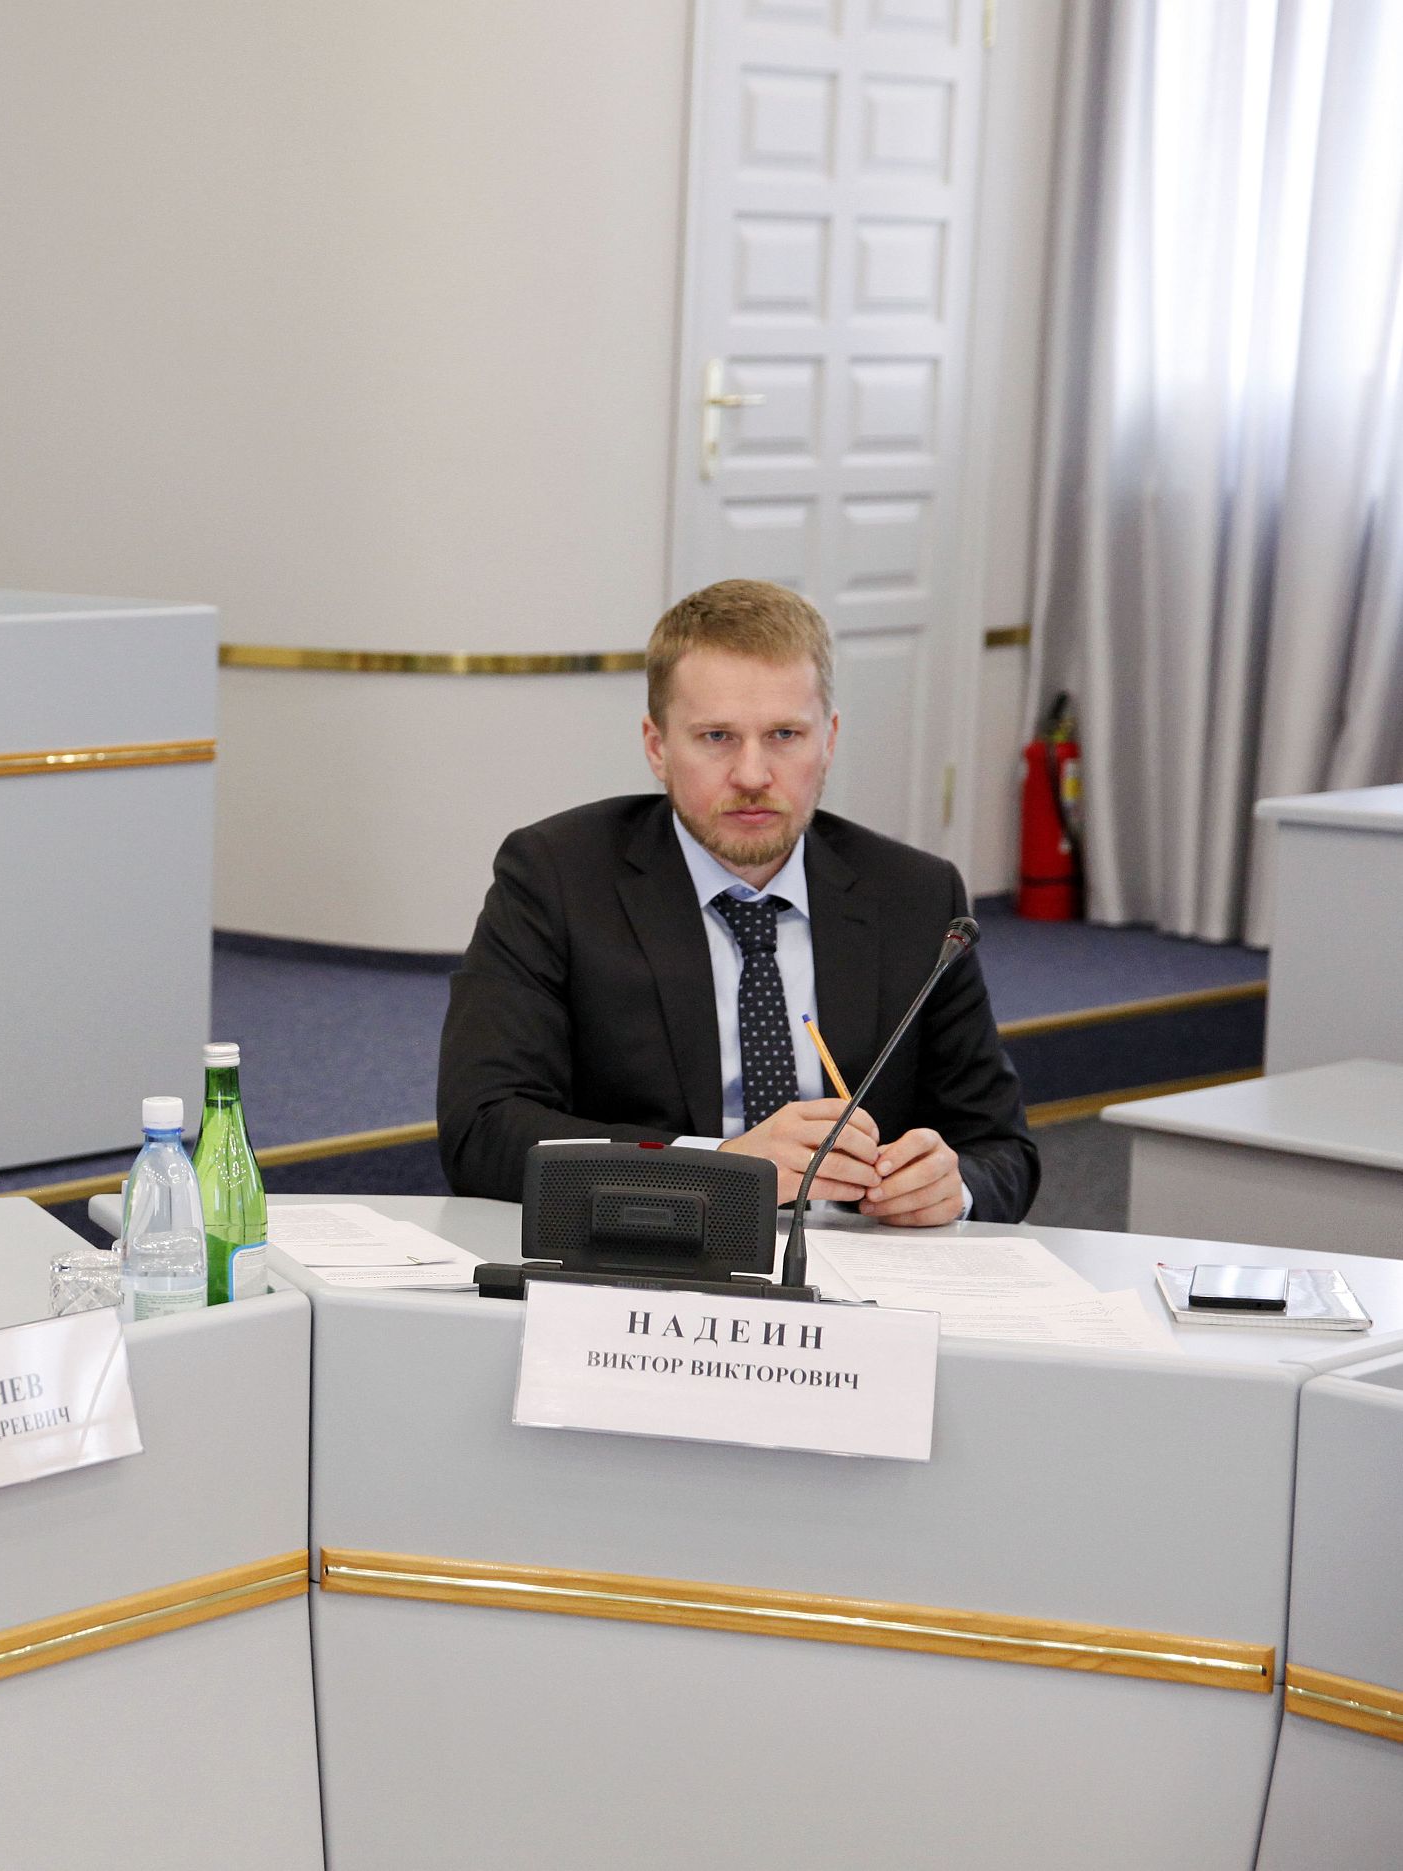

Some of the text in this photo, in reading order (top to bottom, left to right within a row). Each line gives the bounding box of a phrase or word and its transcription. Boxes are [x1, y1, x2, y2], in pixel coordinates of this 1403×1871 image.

[627, 1310, 824, 1349] НАДЕИН
[587, 1350, 859, 1390] ВИКТОР ВИКТОРОВИЧ
